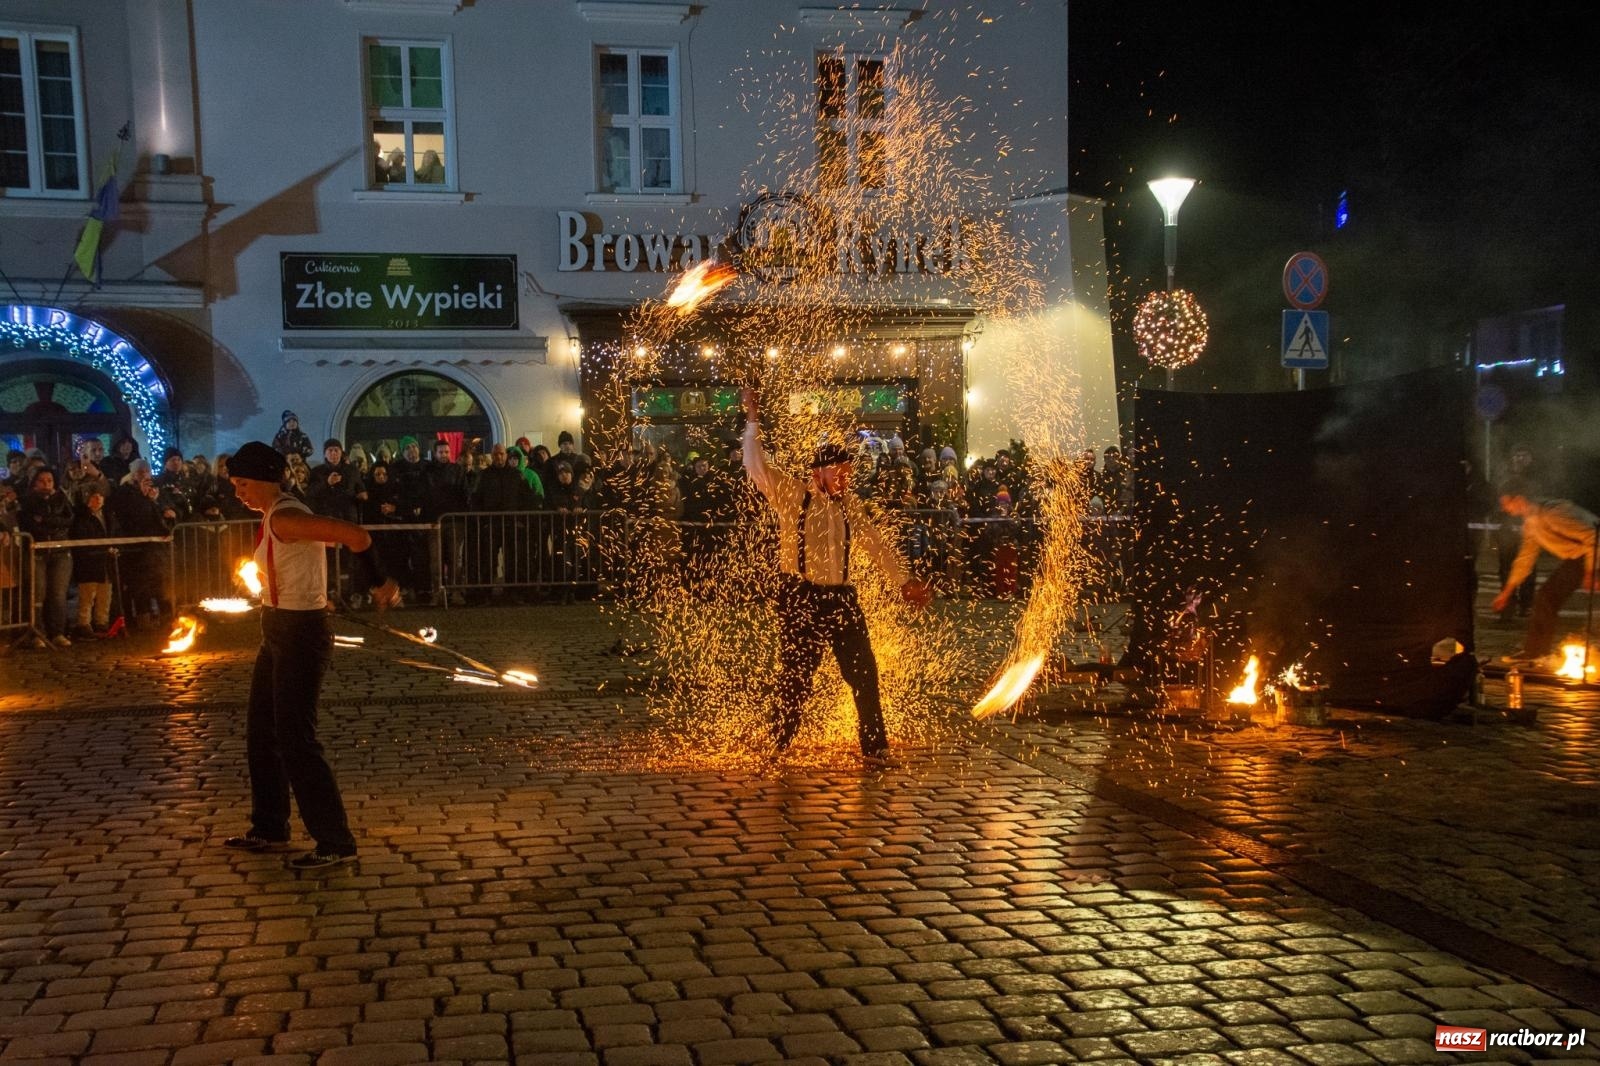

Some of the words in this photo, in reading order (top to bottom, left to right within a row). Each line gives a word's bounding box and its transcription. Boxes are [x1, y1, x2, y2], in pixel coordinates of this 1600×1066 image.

[558, 211, 727, 272] Browar
[305, 260, 361, 275] Cukiernia
[295, 281, 372, 309] Złote
[380, 281, 503, 316] Wypieki
